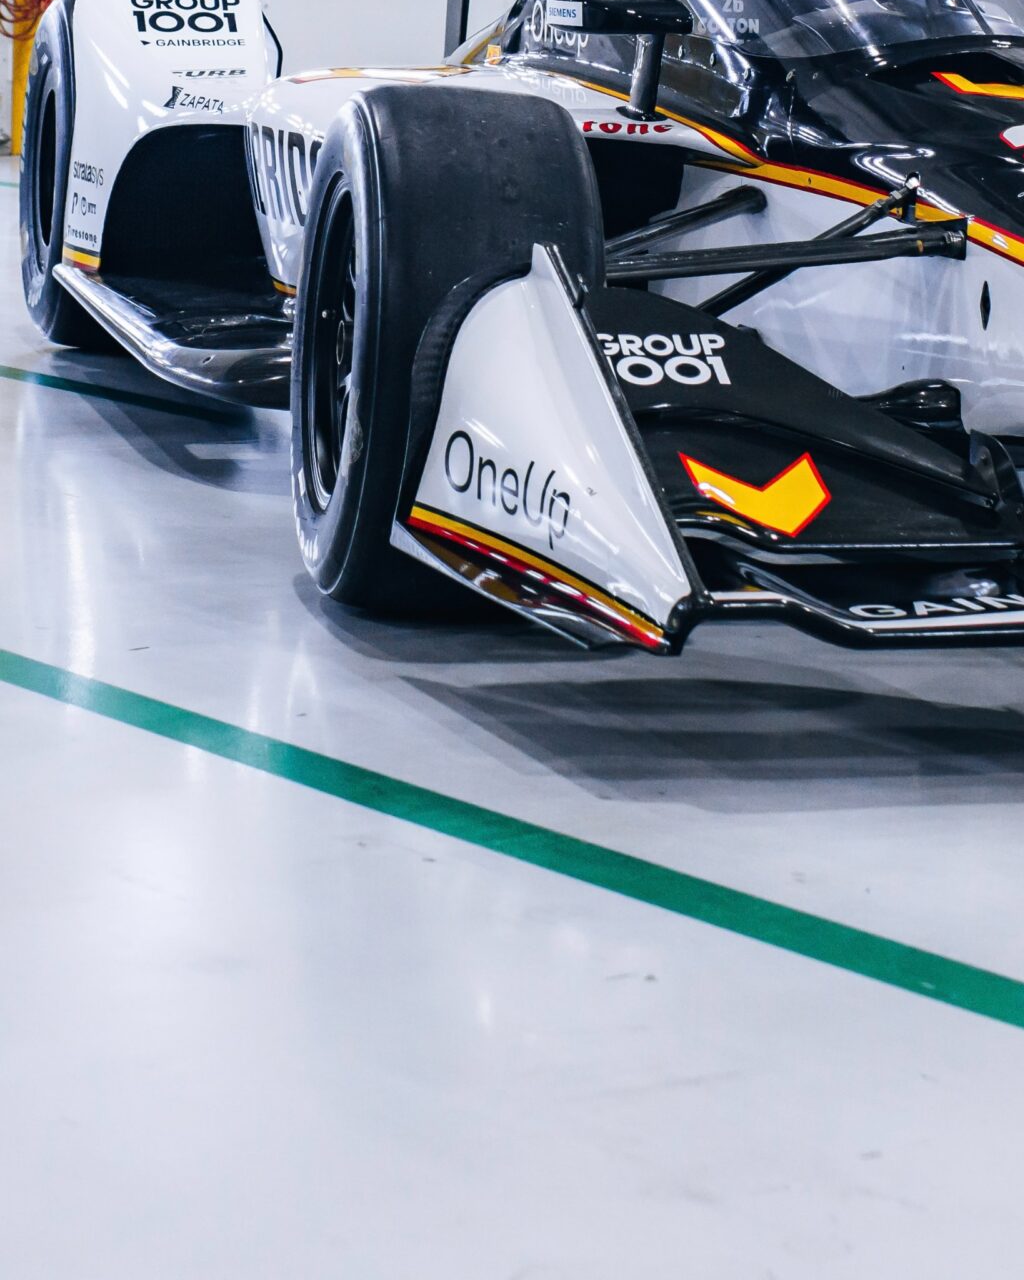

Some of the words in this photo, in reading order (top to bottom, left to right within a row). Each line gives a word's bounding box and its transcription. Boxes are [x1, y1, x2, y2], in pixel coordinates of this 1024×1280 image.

[133, 11, 238, 33] 1001
[549, 7, 577, 19] SIEMENS
[155, 39, 247, 47] GAINBRIDGE
[172, 69, 247, 78] URB
[179, 93, 224, 114] ZAPATA
[73, 160, 104, 188] stratasys
[597, 333, 726, 357] GROUP
[606, 356, 732, 386] 001
[444, 430, 571, 550] OneUp
